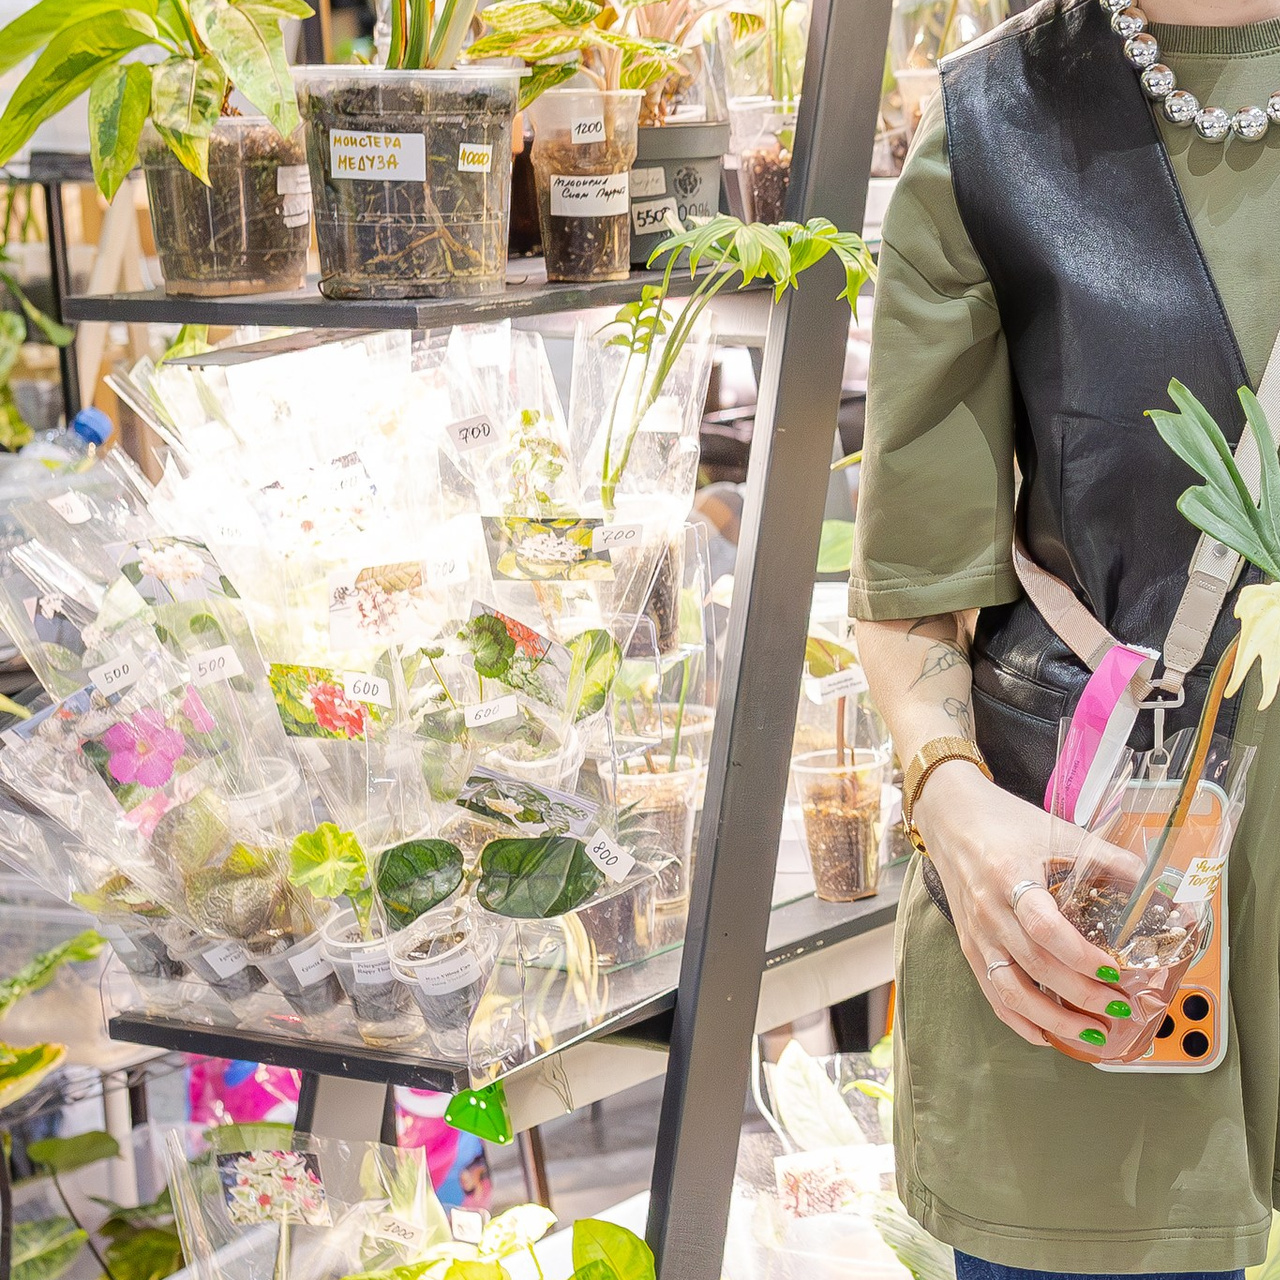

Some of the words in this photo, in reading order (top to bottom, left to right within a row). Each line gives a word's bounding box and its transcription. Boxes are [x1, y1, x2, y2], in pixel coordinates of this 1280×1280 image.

[574, 121, 602, 136] 1200
[337, 153, 399, 171] МЕДУЗА
[459, 422, 491, 444] 700
[602, 529, 636, 544] 700
[104, 663, 130, 685] 500
[198, 656, 226, 678] 500
[353, 680, 380, 697] 600
[474, 704, 501, 721] 600
[593, 841, 619, 866] 800
